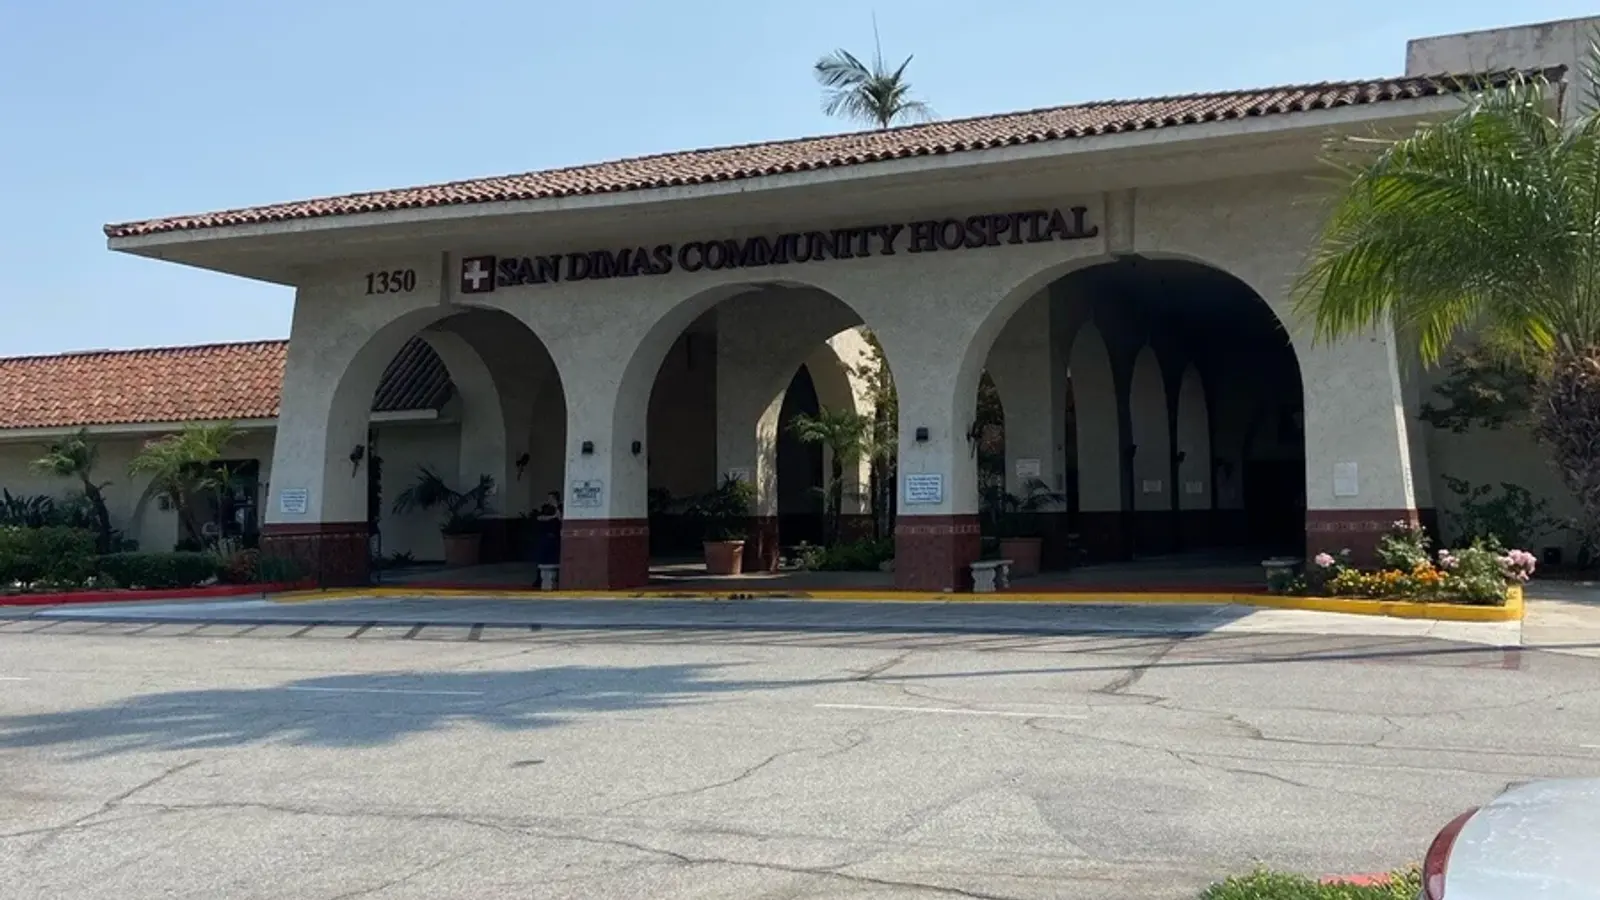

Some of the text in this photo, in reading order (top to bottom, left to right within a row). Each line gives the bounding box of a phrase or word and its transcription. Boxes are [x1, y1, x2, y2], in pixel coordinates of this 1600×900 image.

[497, 207, 1098, 286] SAN DIMAS COMMUNITY HOSPITAL
[365, 269, 416, 295] 1350
